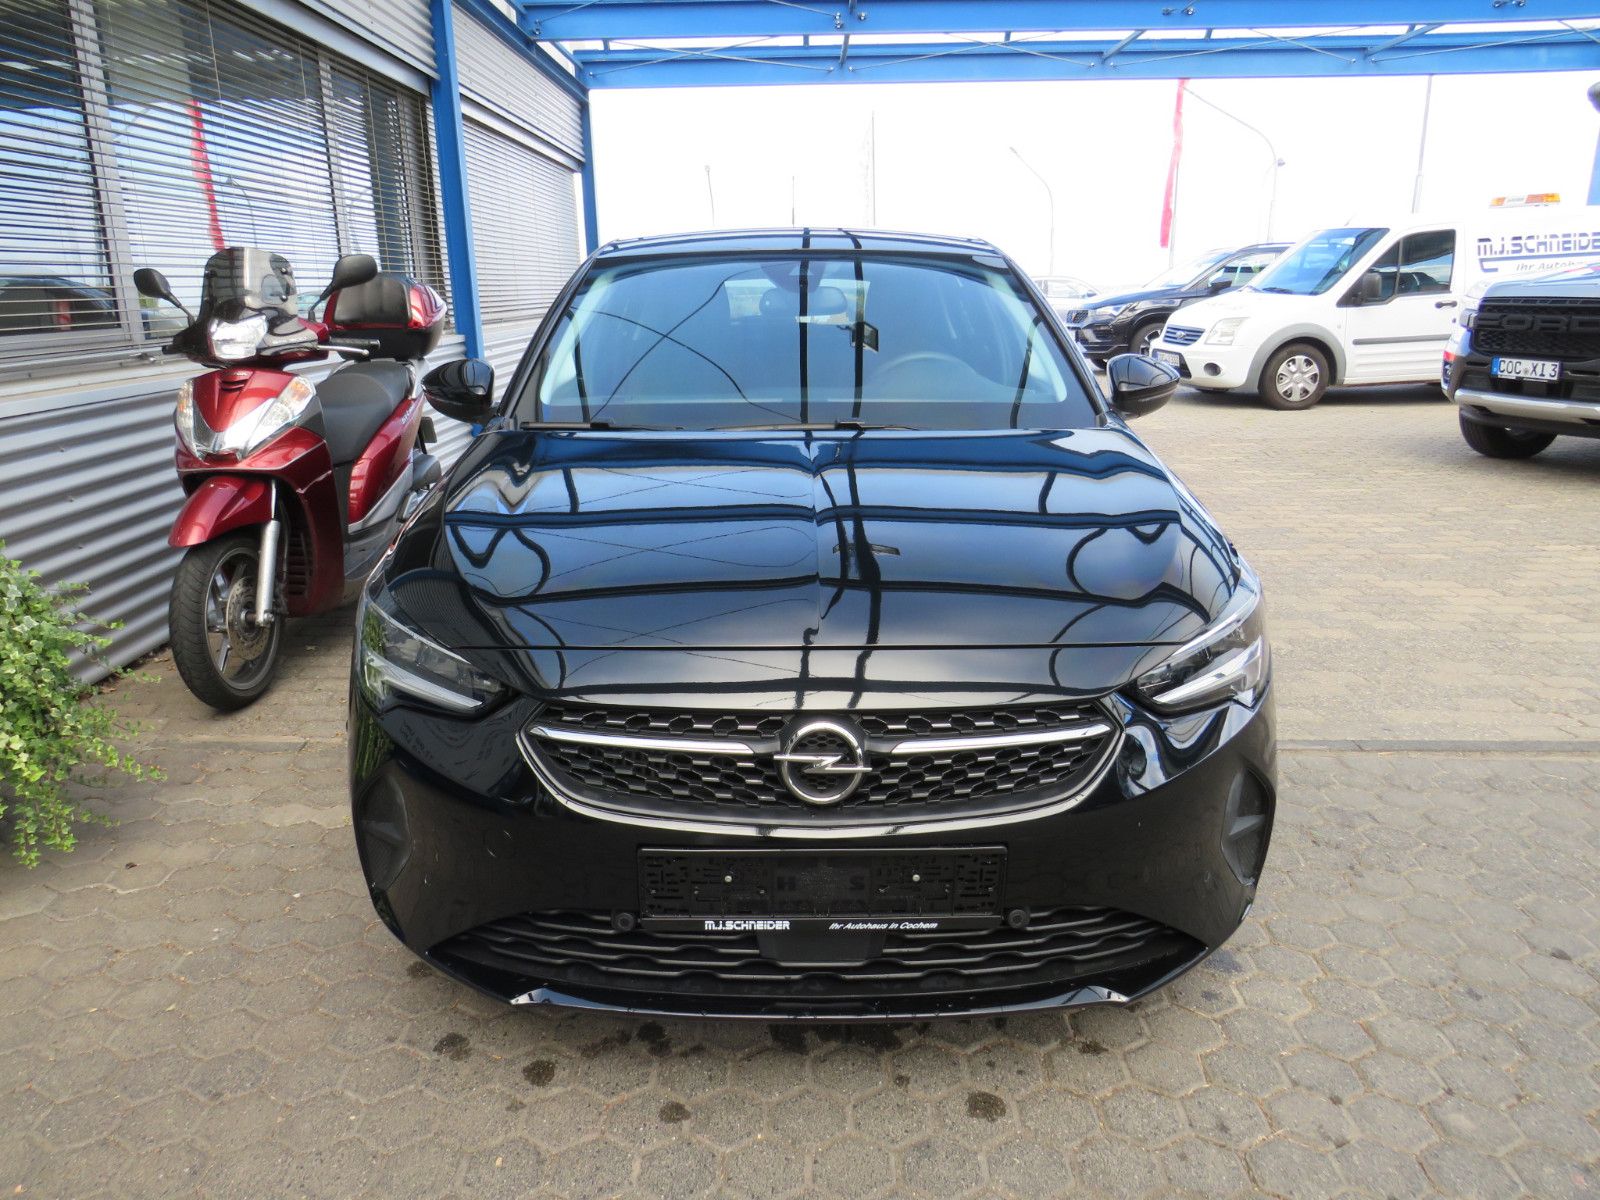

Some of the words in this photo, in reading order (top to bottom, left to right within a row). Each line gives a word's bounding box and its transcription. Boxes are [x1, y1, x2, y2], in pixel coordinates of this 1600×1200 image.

[1516, 263, 1535, 271] Ihr
[1498, 359, 1522, 375] COC
[704, 920, 791, 931] M.J.SCHNEIDER
[828, 922, 844, 930] Ihr
[843, 922, 889, 930] Autohaus
[888, 922, 899, 930] in
[899, 921, 939, 930] Cochem
